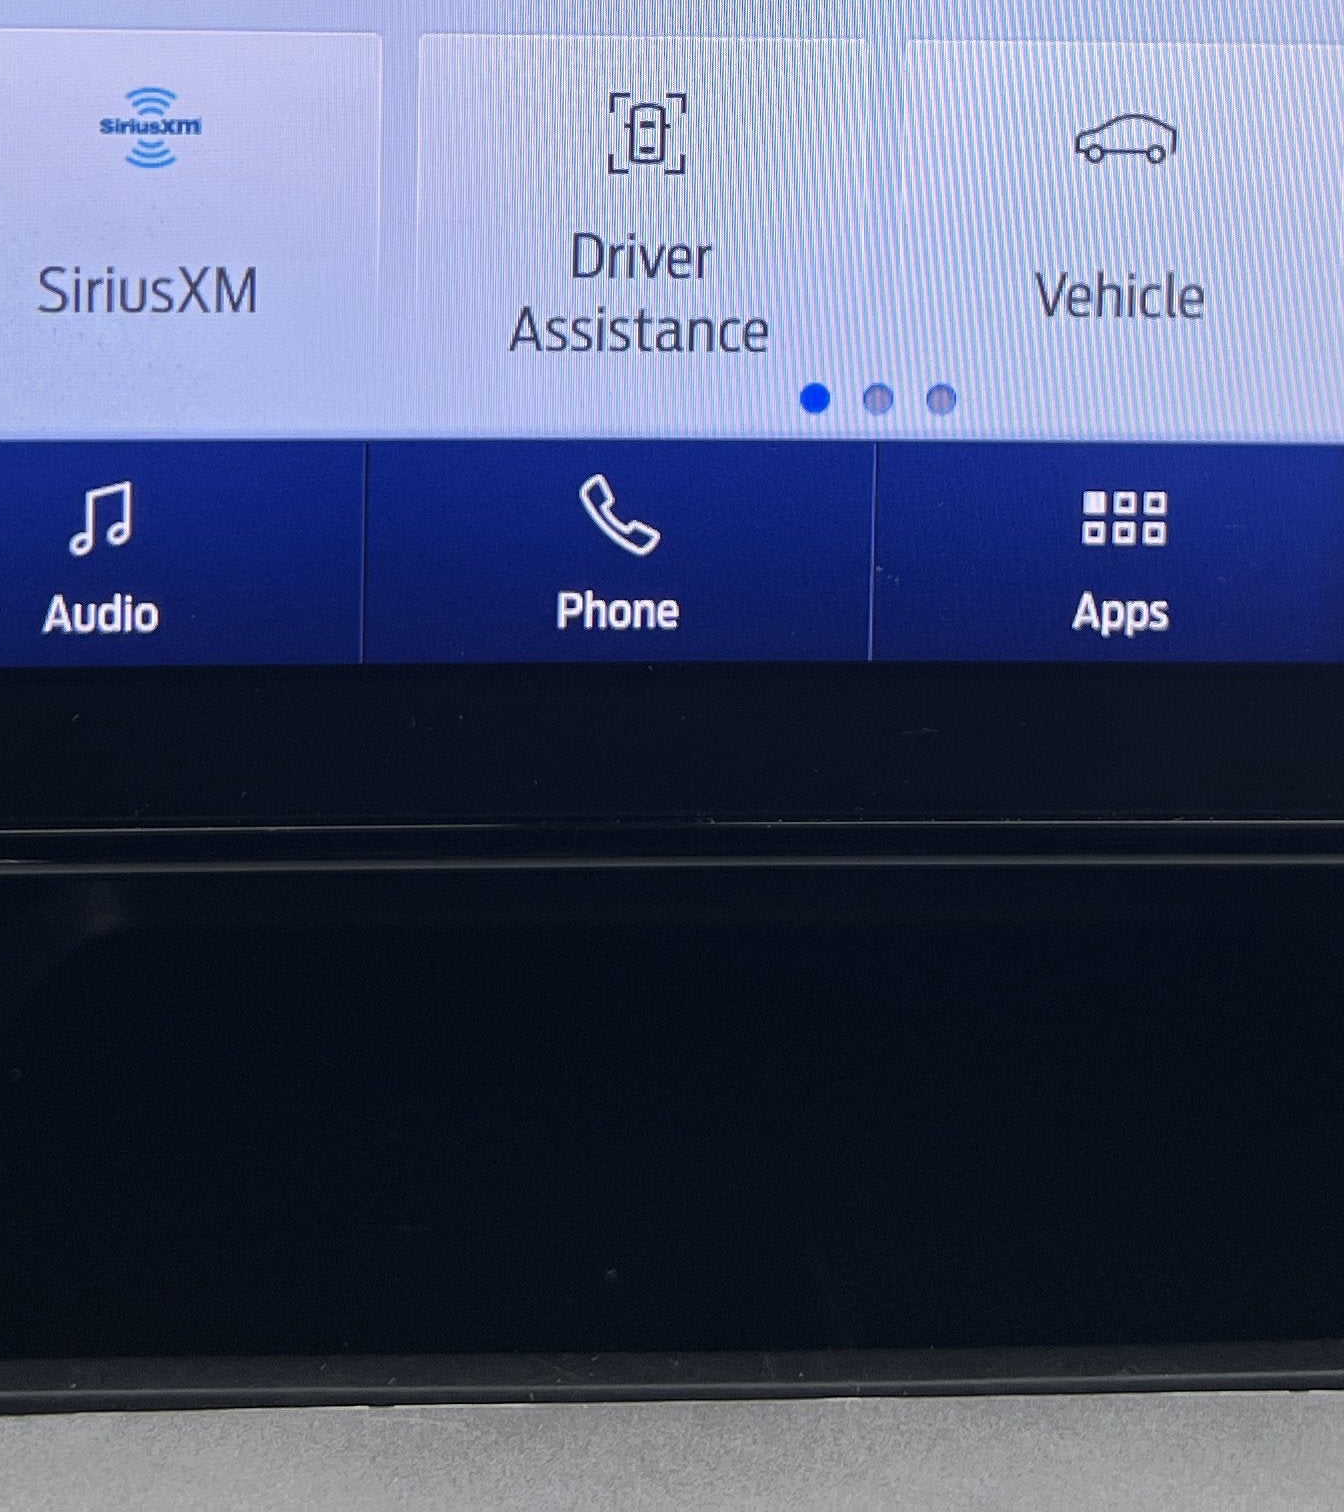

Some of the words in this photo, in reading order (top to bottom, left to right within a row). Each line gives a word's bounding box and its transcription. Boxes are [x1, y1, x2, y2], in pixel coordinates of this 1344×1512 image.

[570, 231, 712, 281] Driver
[37, 265, 258, 315] SiriusXM
[1037, 271, 1206, 320] Vehicle
[508, 304, 769, 354] Assistance
[42, 592, 161, 635] Audio
[556, 590, 681, 632] Phone
[1072, 592, 1171, 636] Apps
